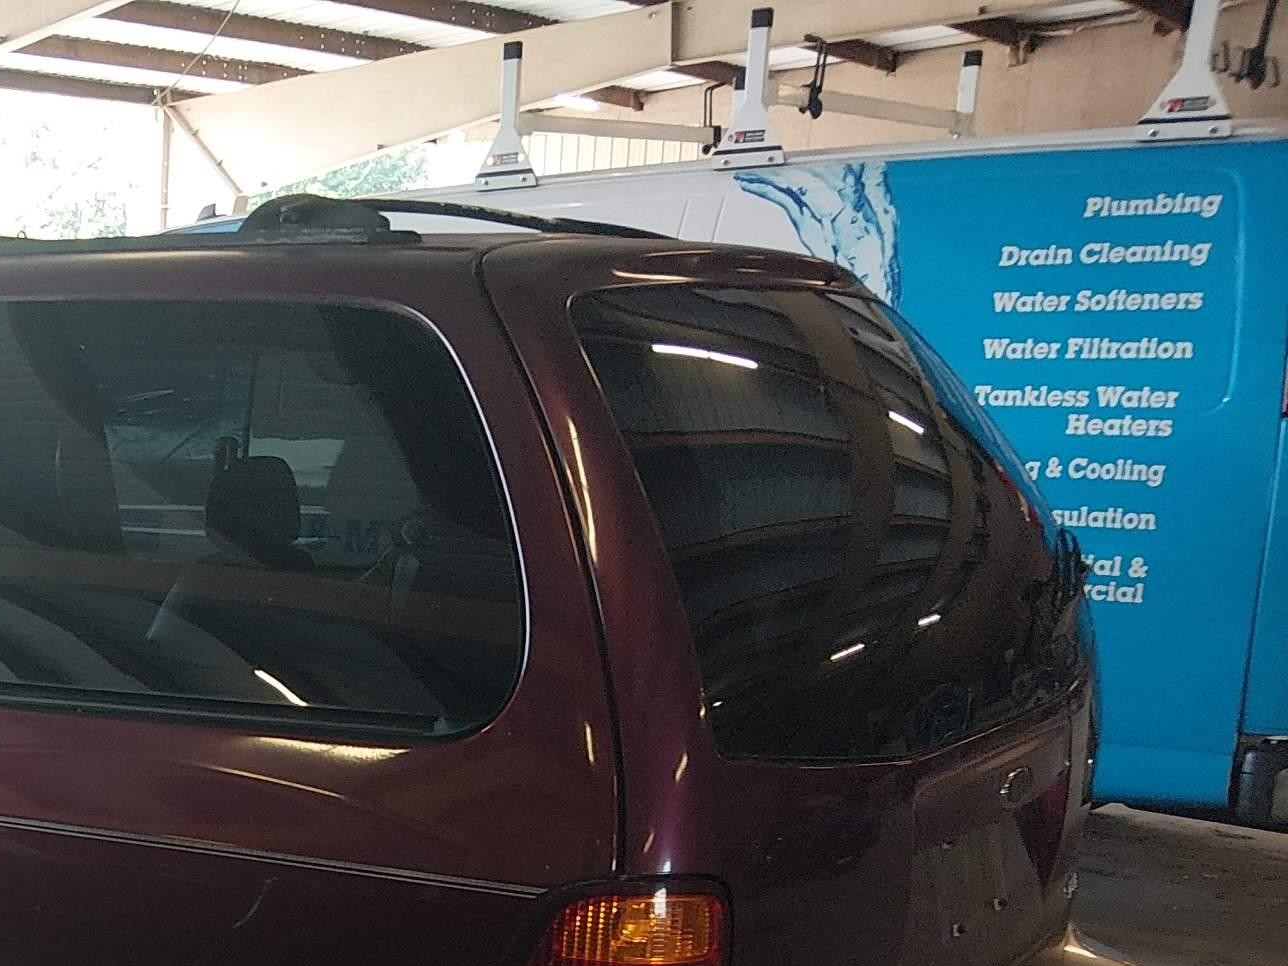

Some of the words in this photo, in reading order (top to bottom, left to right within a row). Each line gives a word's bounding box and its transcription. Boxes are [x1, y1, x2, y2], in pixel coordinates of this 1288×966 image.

[1082, 192, 1224, 219] Plumbing
[998, 244, 1073, 267] Drain
[1078, 239, 1213, 267] Cleaning
[992, 291, 1071, 313] Water
[1073, 289, 1205, 312] Softeners
[982, 338, 1062, 360] Water
[1064, 337, 1194, 360] Filtration
[973, 385, 1090, 407] Tankless
[1096, 385, 1180, 409] Water
[1064, 413, 1173, 437] Heaters
[1044, 456, 1063, 479] &
[1067, 457, 1167, 488] Cooling
[1127, 556, 1150, 578] &
